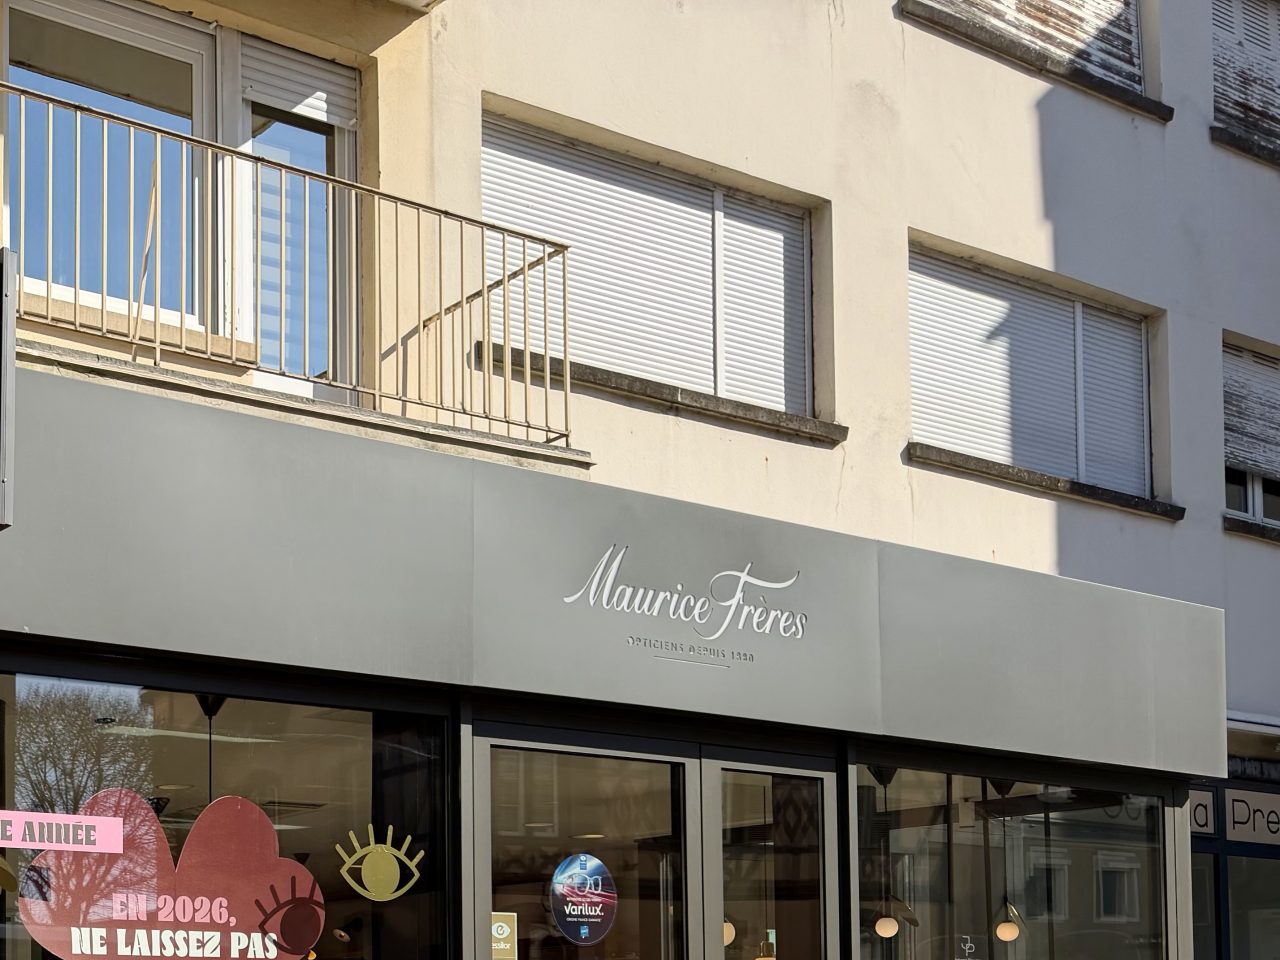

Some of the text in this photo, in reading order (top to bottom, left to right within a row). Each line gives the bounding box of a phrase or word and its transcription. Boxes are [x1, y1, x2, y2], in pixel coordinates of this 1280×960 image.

[563, 543, 808, 640] Maurice Frères
[626, 636, 684, 653] OPTICIENS
[688, 644, 726, 659] DEPUIS
[21, 821, 97, 846] ANNÉE
[111, 893, 237, 928] EN 2026,
[70, 927, 278, 960] NE LAISSEZ PAS
